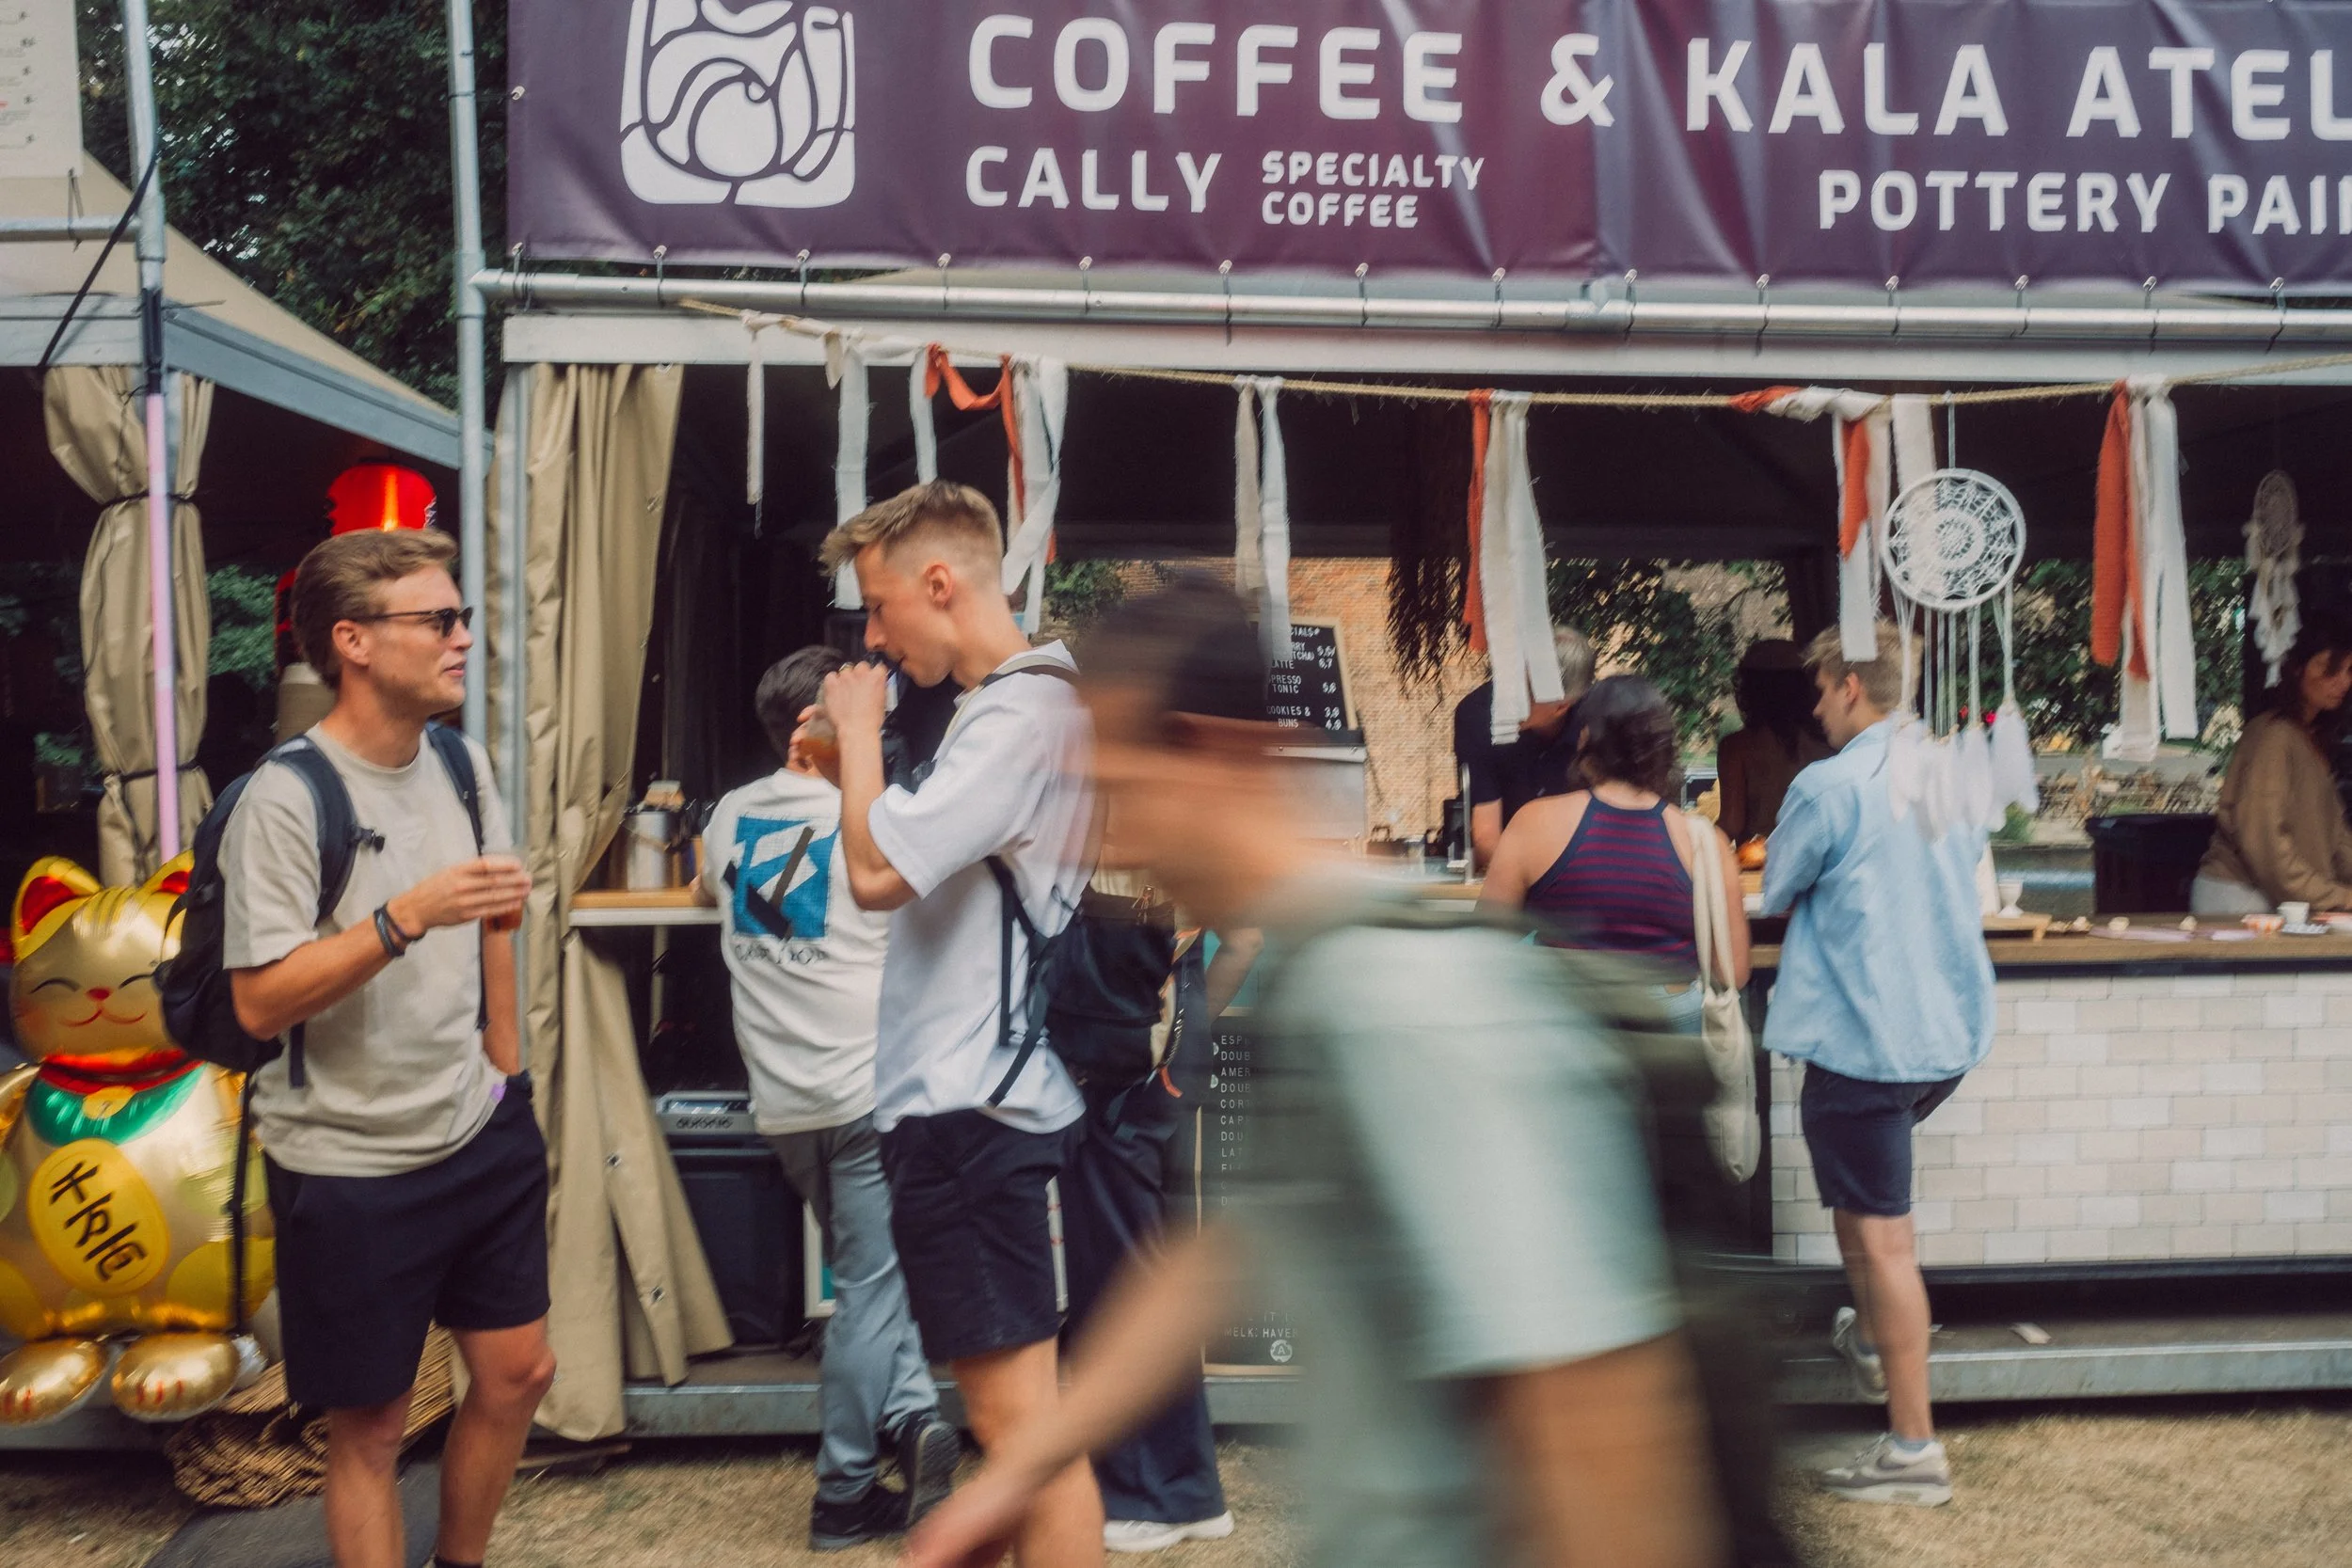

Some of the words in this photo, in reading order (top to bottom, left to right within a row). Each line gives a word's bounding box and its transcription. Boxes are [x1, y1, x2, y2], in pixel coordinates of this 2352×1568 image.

[968, 13, 1463, 124] COFFEE
[1540, 33, 1615, 128] &
[1686, 37, 2010, 137] KALA
[1261, 150, 1486, 191] SPECIALTY
[965, 145, 1223, 214] CALLY
[1819, 169, 2171, 234] POTTERY
[1261, 191, 1419, 229] COFFEE
[1270, 674, 1301, 685] PRESSO
[1272, 684, 1299, 693] TONIC
[1278, 718, 1299, 728] BUNS
[1221, 1035, 1249, 1045] ESP
[1220, 1051, 1250, 1061] DOUB
[1220, 1067, 1251, 1077] AMER
[1220, 1083, 1251, 1093] DOUB
[1220, 1131, 1244, 1141] DOU
